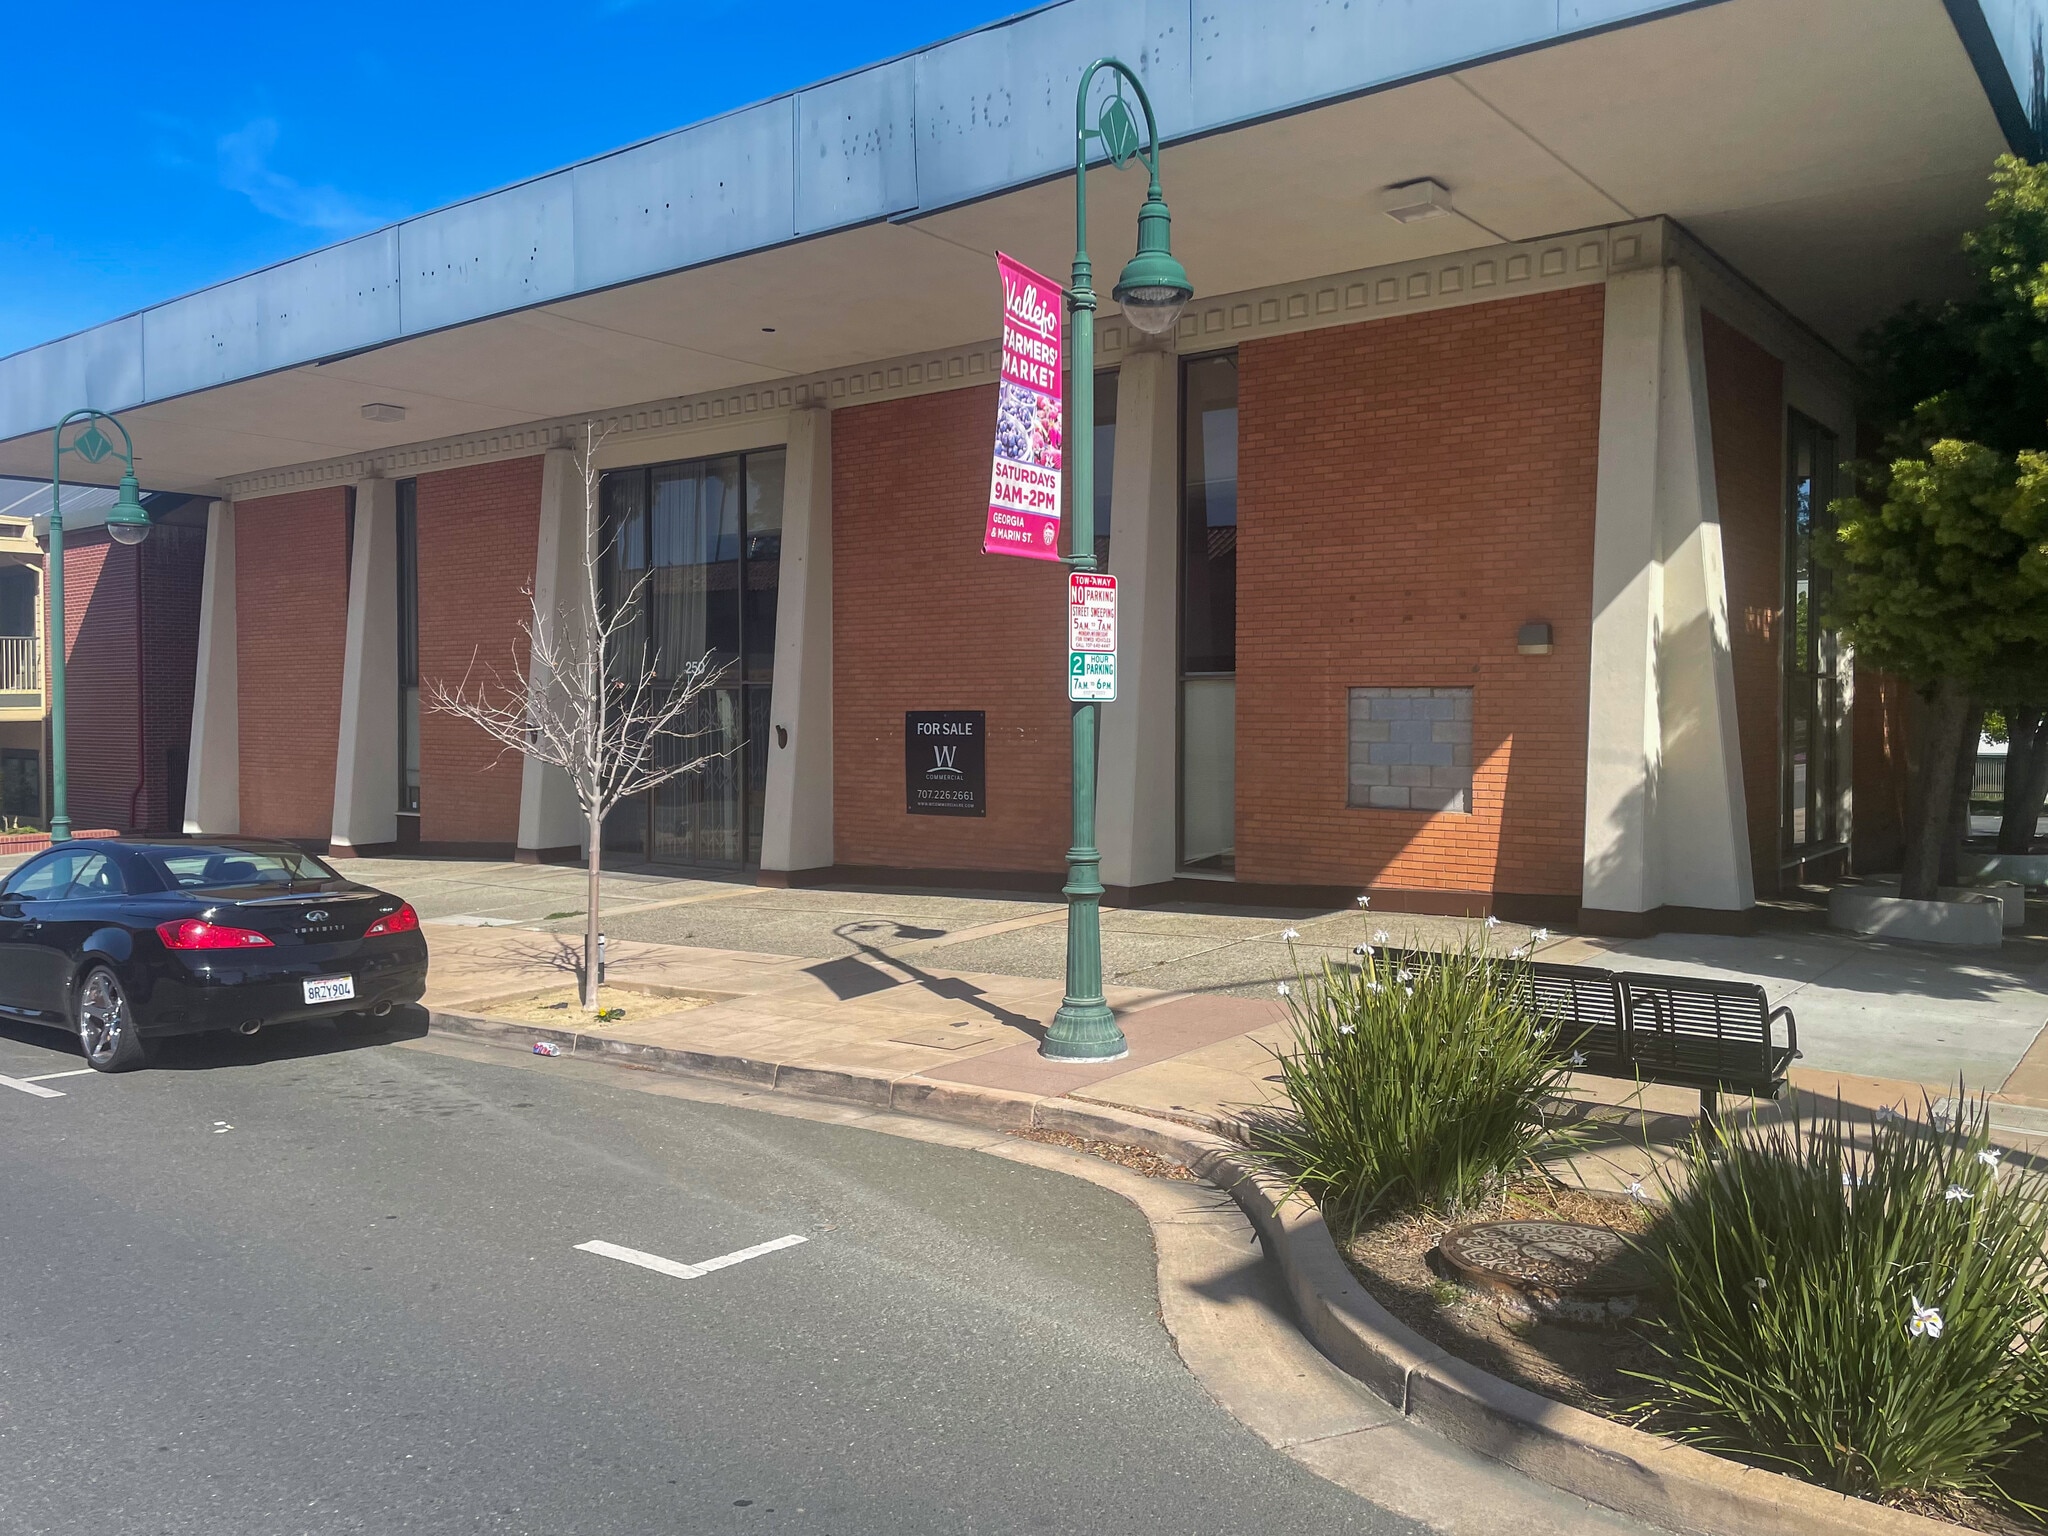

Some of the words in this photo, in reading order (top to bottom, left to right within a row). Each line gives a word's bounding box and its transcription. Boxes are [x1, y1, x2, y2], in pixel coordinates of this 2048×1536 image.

[1005, 276, 1057, 339] Vallejo
[1004, 325, 1058, 367] FARMERS'
[1002, 350, 1055, 389] MARKET
[995, 462, 1056, 489] SATURDAYS
[994, 482, 1055, 511] 9AM-2PM
[993, 512, 1024, 528] GEORGIA
[991, 527, 996, 538] &
[997, 528, 1021, 541] MARIN
[1022, 531, 1033, 544] ST.
[1075, 576, 1111, 587] TOW-AWAY
[1072, 586, 1084, 604] NO
[1086, 590, 1114, 603] PARKING
[1073, 606, 1089, 617] STREET
[1091, 607, 1114, 619] SWEEPING
[685, 661, 705, 674] 250
[1073, 655, 1082, 673] 2
[1091, 655, 1109, 663] HOUR
[1086, 663, 1113, 675] PARKING
[917, 722, 940, 735] FOR
[942, 722, 973, 735] SALE
[934, 745, 957, 767] W
[917, 789, 974, 801] 707.226.2661
[308, 983, 351, 1000] 8RZY904
